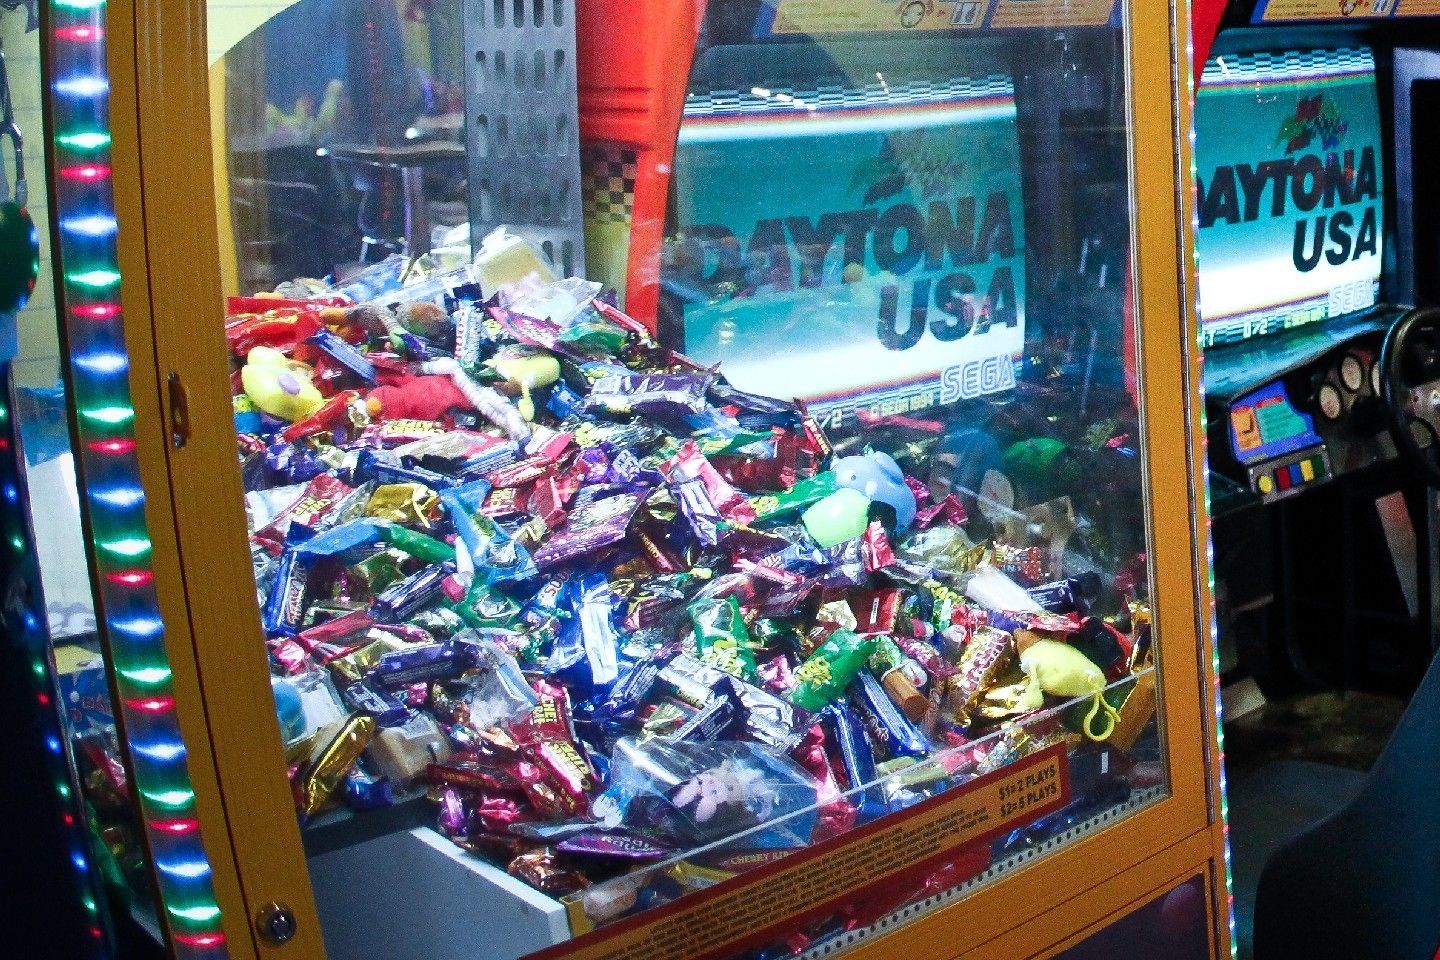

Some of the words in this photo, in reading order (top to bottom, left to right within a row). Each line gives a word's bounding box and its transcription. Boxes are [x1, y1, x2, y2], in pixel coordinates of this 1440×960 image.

[687, 191, 1016, 299] DAYTONA
[1292, 206, 1377, 274] USA
[876, 267, 1017, 352] USA
[939, 355, 1017, 405] SEGA
